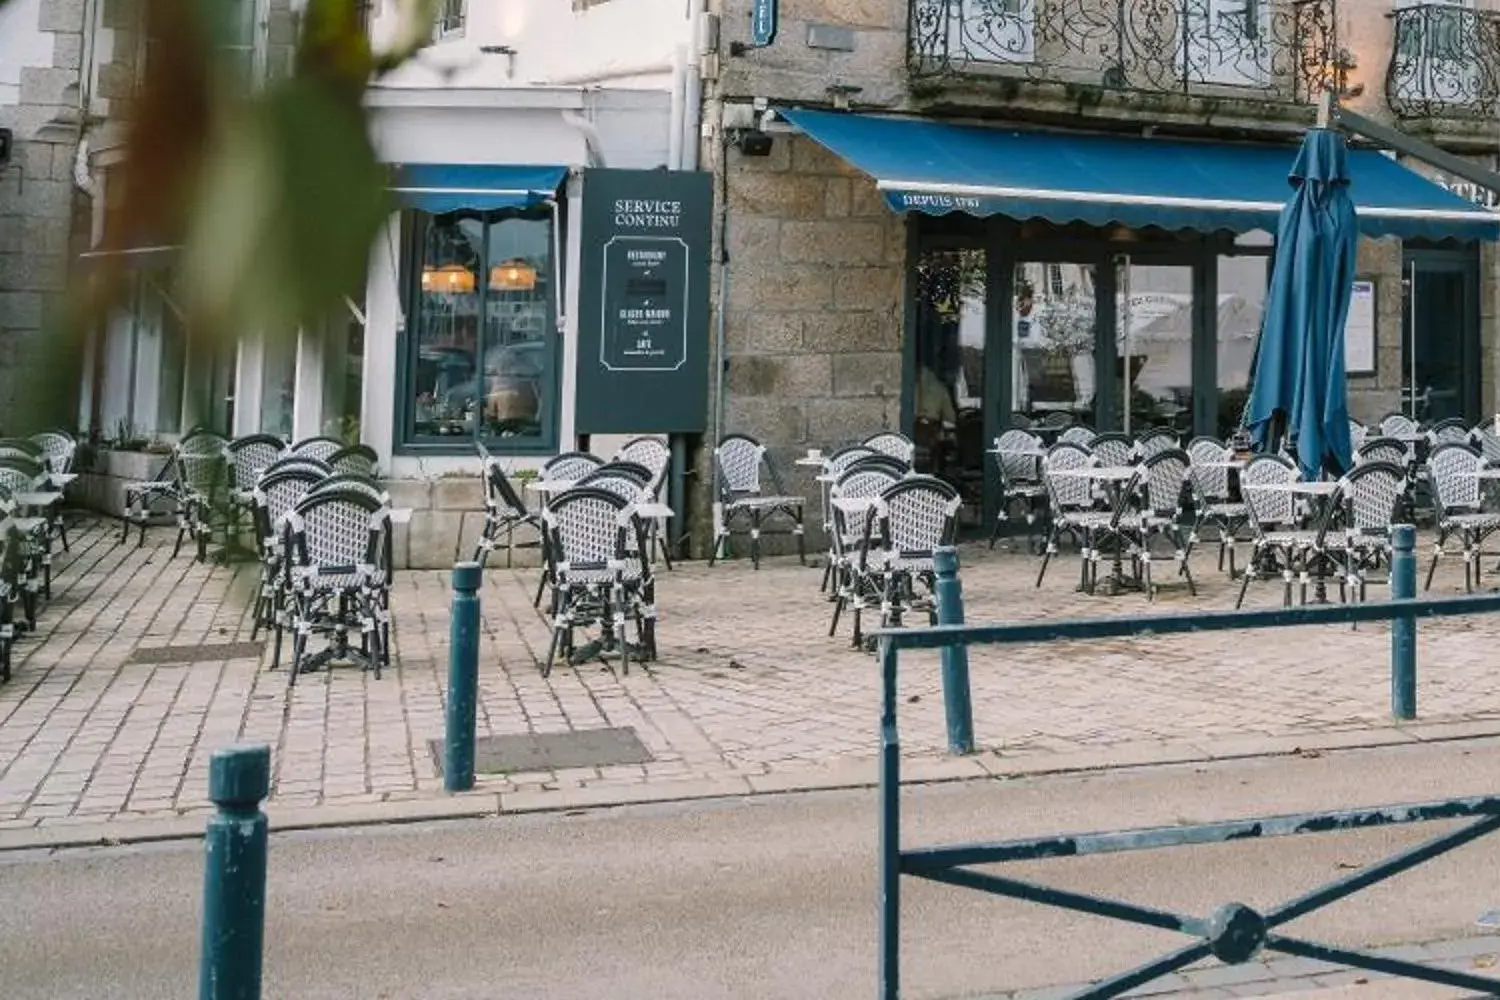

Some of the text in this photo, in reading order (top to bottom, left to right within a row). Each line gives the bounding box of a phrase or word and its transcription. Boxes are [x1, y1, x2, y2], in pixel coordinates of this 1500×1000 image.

[615, 200, 681, 214] SERVICE
[903, 194, 952, 207] DEPUIS
[615, 214, 680, 228] CONTINU
